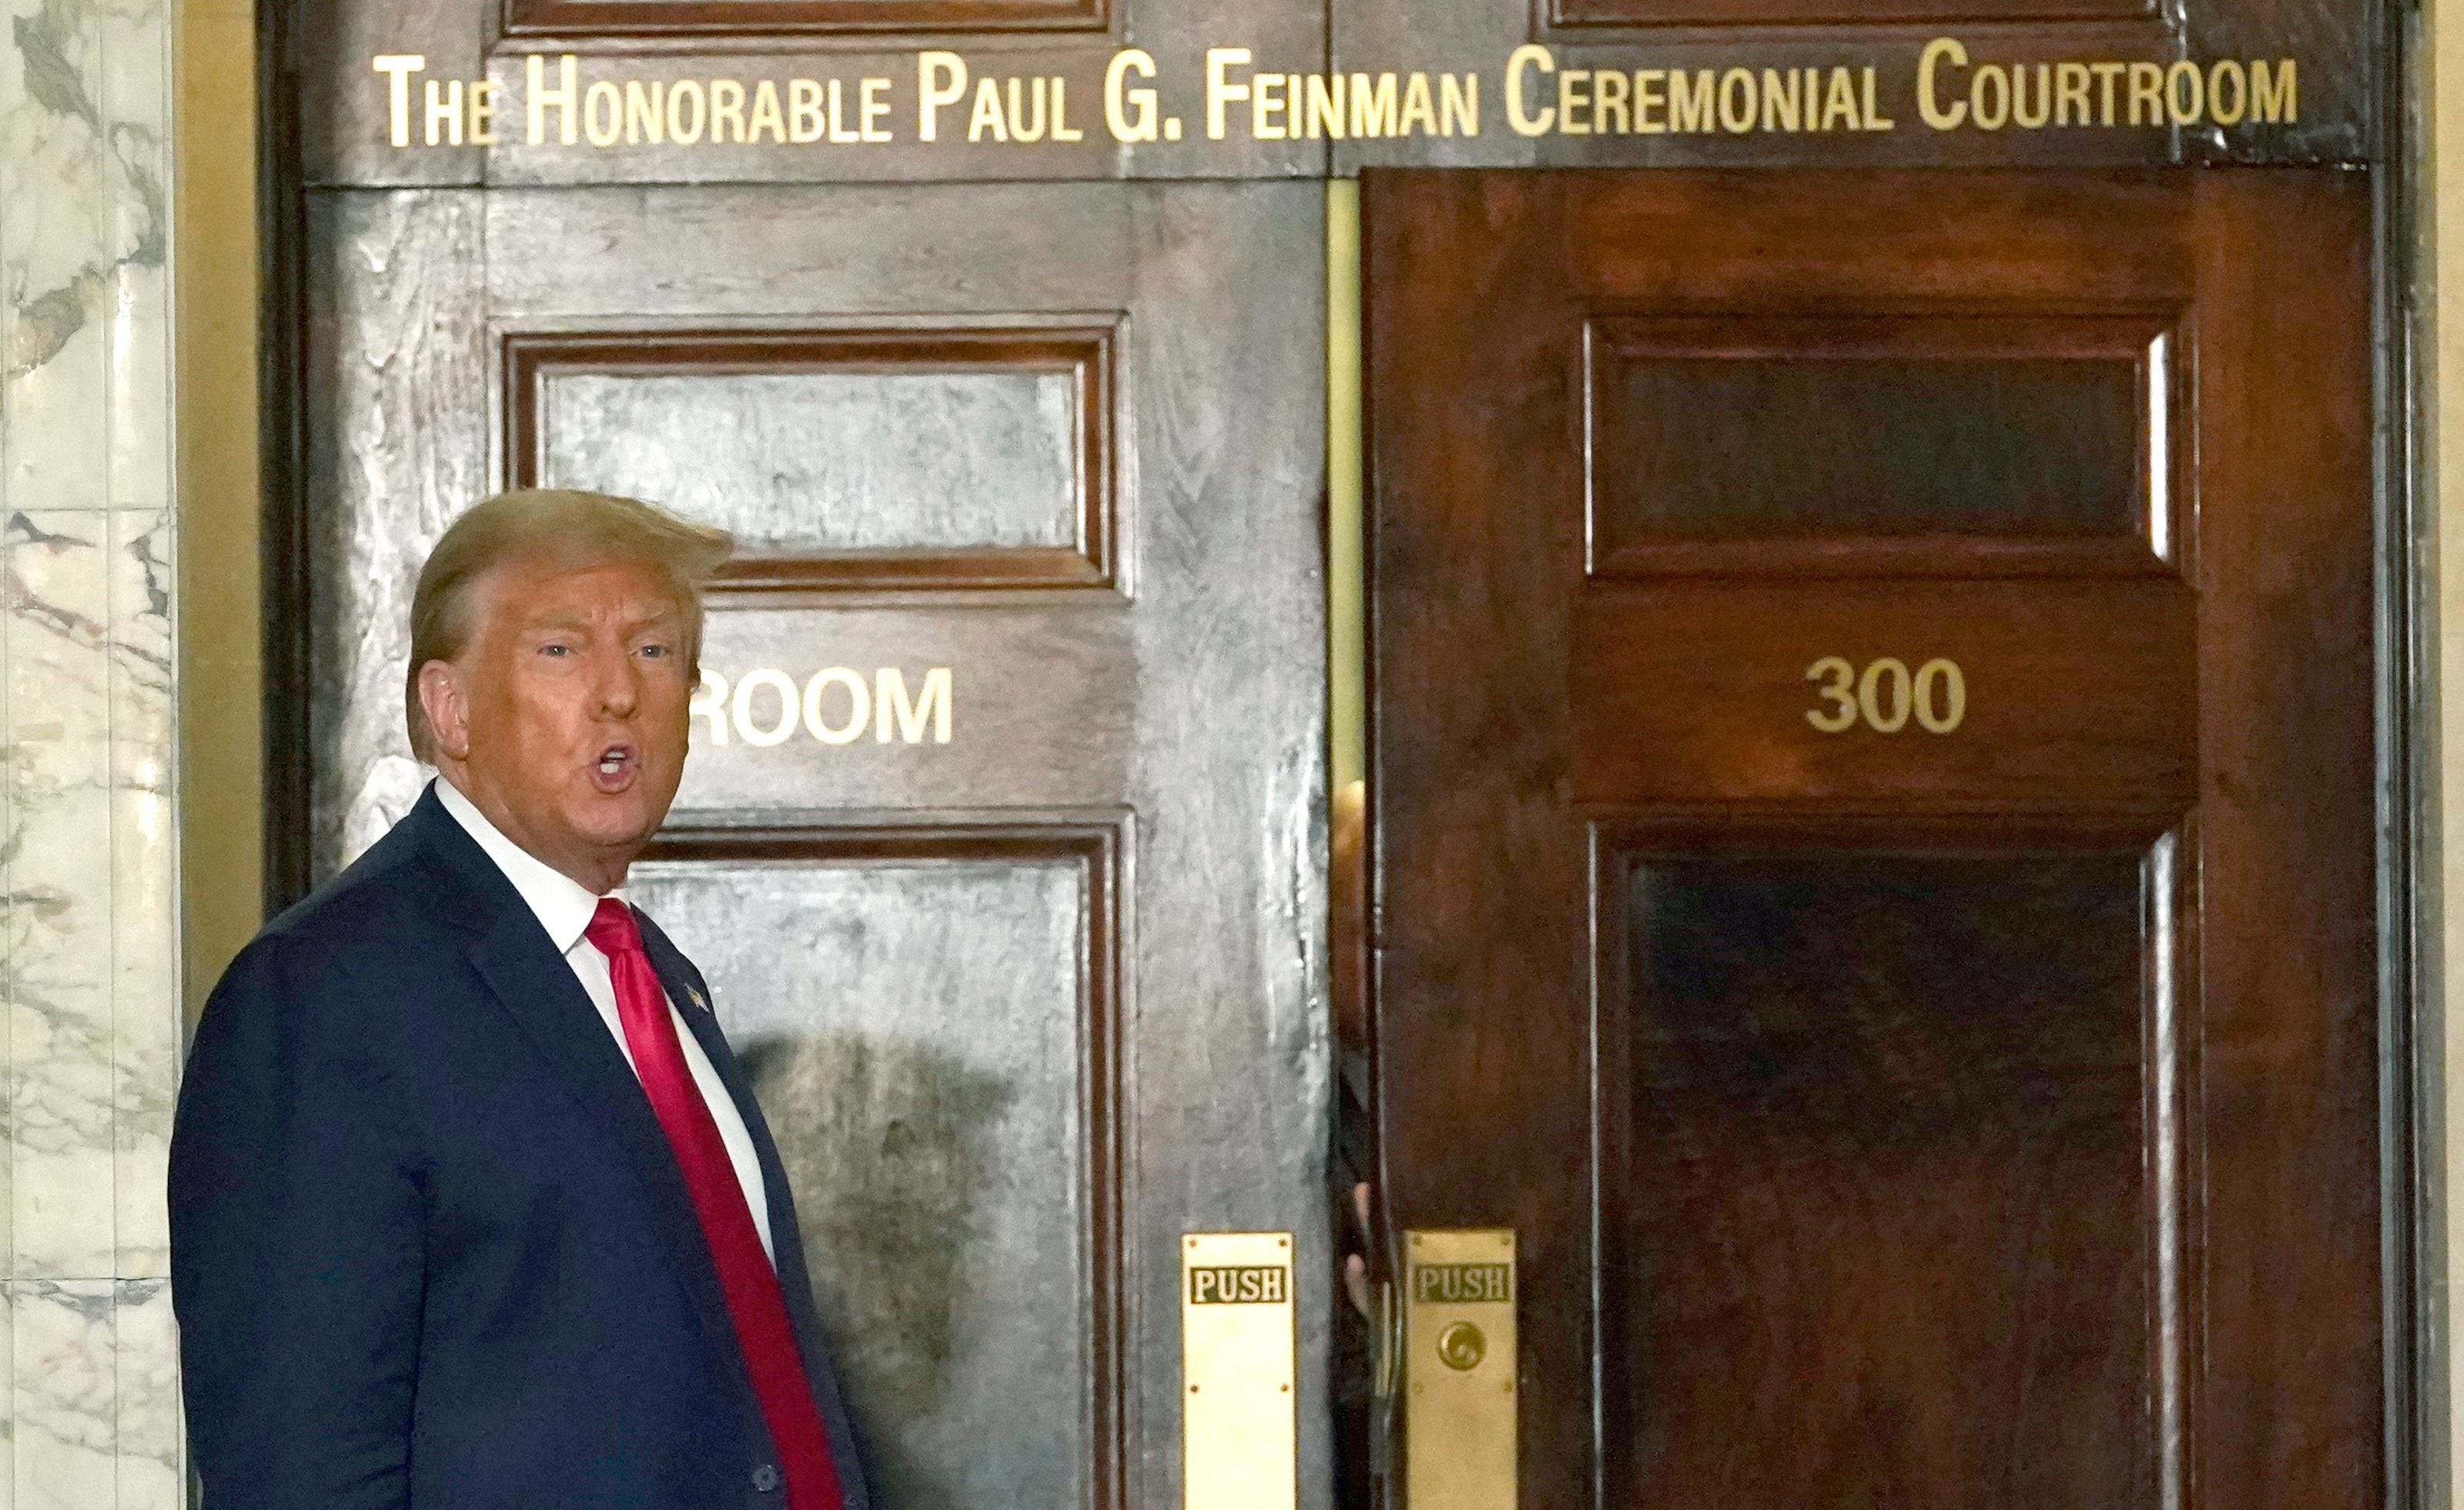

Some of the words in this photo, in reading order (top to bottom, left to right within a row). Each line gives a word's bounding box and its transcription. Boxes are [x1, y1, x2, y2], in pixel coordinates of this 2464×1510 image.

[526, 53, 893, 146] HONORABLE
[917, 49, 1083, 143] PAUL
[1104, 48, 1182, 143] G.
[1206, 46, 1479, 140] FEINMAN
[1504, 43, 1894, 136] CEREMONIAL
[1916, 36, 2298, 131] COURTROOM
[688, 666, 953, 747] ROOM
[1805, 655, 1966, 734] 300
[1195, 1268, 1283, 1302] PUSH
[1418, 1265, 1509, 1300] PUSH
